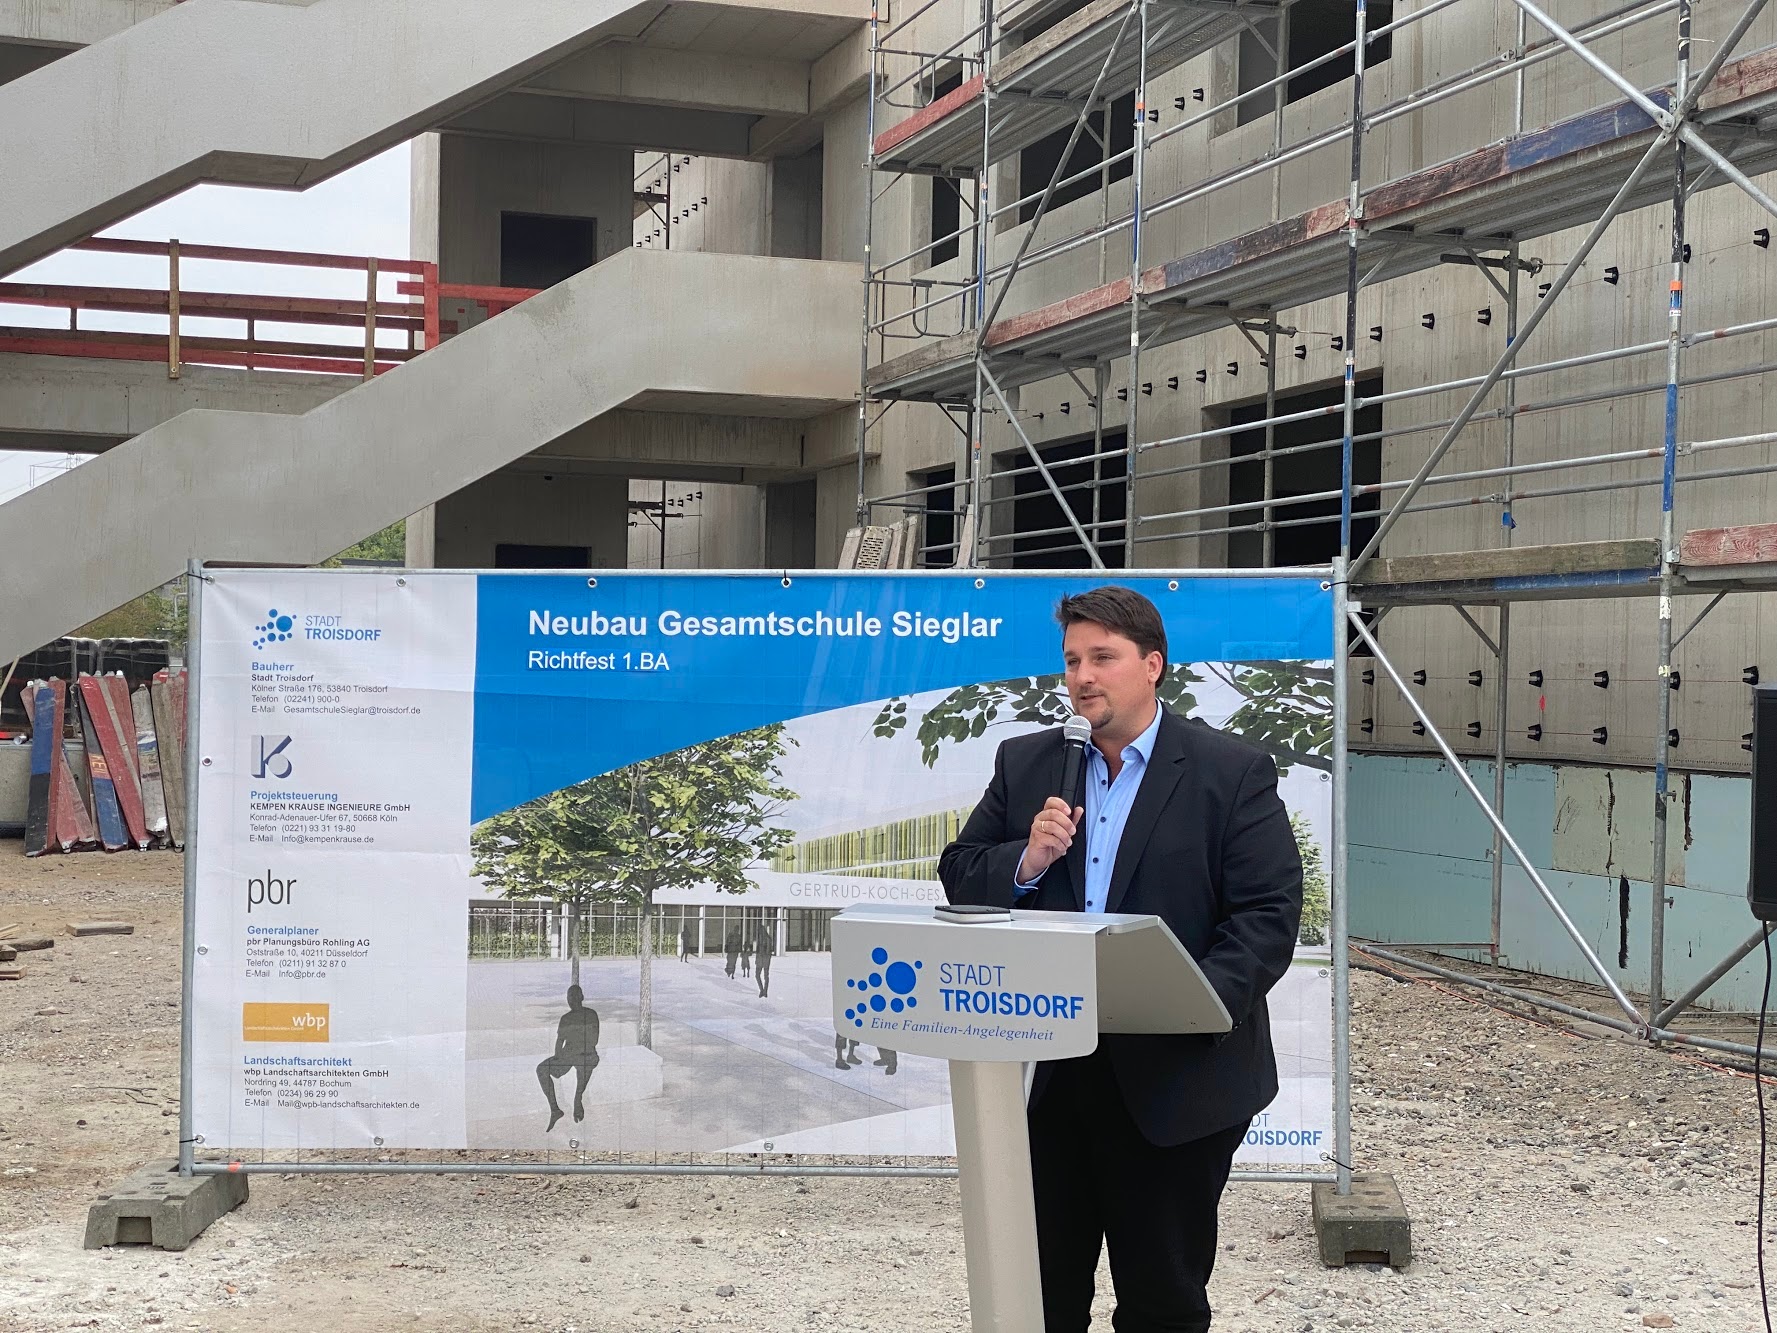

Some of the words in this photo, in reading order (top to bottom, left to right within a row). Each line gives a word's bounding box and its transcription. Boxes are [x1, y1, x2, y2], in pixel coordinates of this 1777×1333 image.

[305, 615, 342, 626] STADT
[528, 610, 648, 636] Neubau
[658, 610, 882, 637] Gesamtschule
[892, 611, 1002, 643] Sieglar
[304, 628, 382, 641] TROISDORF
[528, 650, 615, 670] Richtfest
[622, 651, 670, 671] 1.BA
[251, 662, 294, 671] Bauherr
[276, 674, 314, 682] Troisdorf
[251, 684, 276, 692] Kölner
[308, 685, 325, 693] 176,
[326, 685, 351, 693] 53840
[354, 685, 388, 693] Troisdorf
[284, 695, 315, 704] (02241)
[317, 695, 340, 703] 900-0
[284, 706, 421, 715] GesamtschuleSieglar@troisdorf.de
[250, 791, 338, 802] Projektsteuerung
[250, 803, 287, 811] KEMPEN
[288, 803, 325, 811] KRAUSE
[327, 803, 382, 811] INGENIEURE
[384, 804, 411, 812] GmbH
[250, 814, 337, 822] Konrad-Adenauer-Ufer
[338, 814, 351, 823] 67,
[353, 814, 378, 822] 50668
[380, 814, 398, 822] Köln
[250, 824, 277, 832] Telefon
[281, 825, 307, 833] (0221)
[281, 835, 375, 844] Info@kempenkrause.de
[247, 869, 297, 913] pbr
[247, 926, 320, 936] Generalplaner
[246, 938, 261, 947] pbr
[263, 938, 321, 948] Planungsbüro
[322, 939, 355, 948] Rohling
[356, 939, 370, 947] AG
[246, 948, 285, 956] Oststraße
[300, 949, 324, 957] 40211
[326, 949, 369, 957] Düsseldorf
[246, 959, 274, 967] Telefon
[279, 959, 304, 968] (0211)
[279, 970, 326, 979] Info@pbr.de
[939, 962, 1006, 987] STADT
[939, 988, 1084, 1020] TROISDORF
[292, 1012, 326, 1031] wbp
[870, 1017, 899, 1031] Eine
[902, 1020, 1055, 1042] Familien-Angelegenheit
[244, 1056, 352, 1067] Landschaftsarchitekt
[243, 1068, 261, 1077] wbp
[263, 1068, 360, 1077] Landschaftsarchitekten
[362, 1070, 389, 1078] GmbH
[244, 1079, 277, 1087] Nordring
[293, 1079, 317, 1087] 44787
[245, 1088, 272, 1096] Telefon
[277, 1089, 303, 1098] (0234)
[1242, 1130, 1323, 1146] OISDORF
